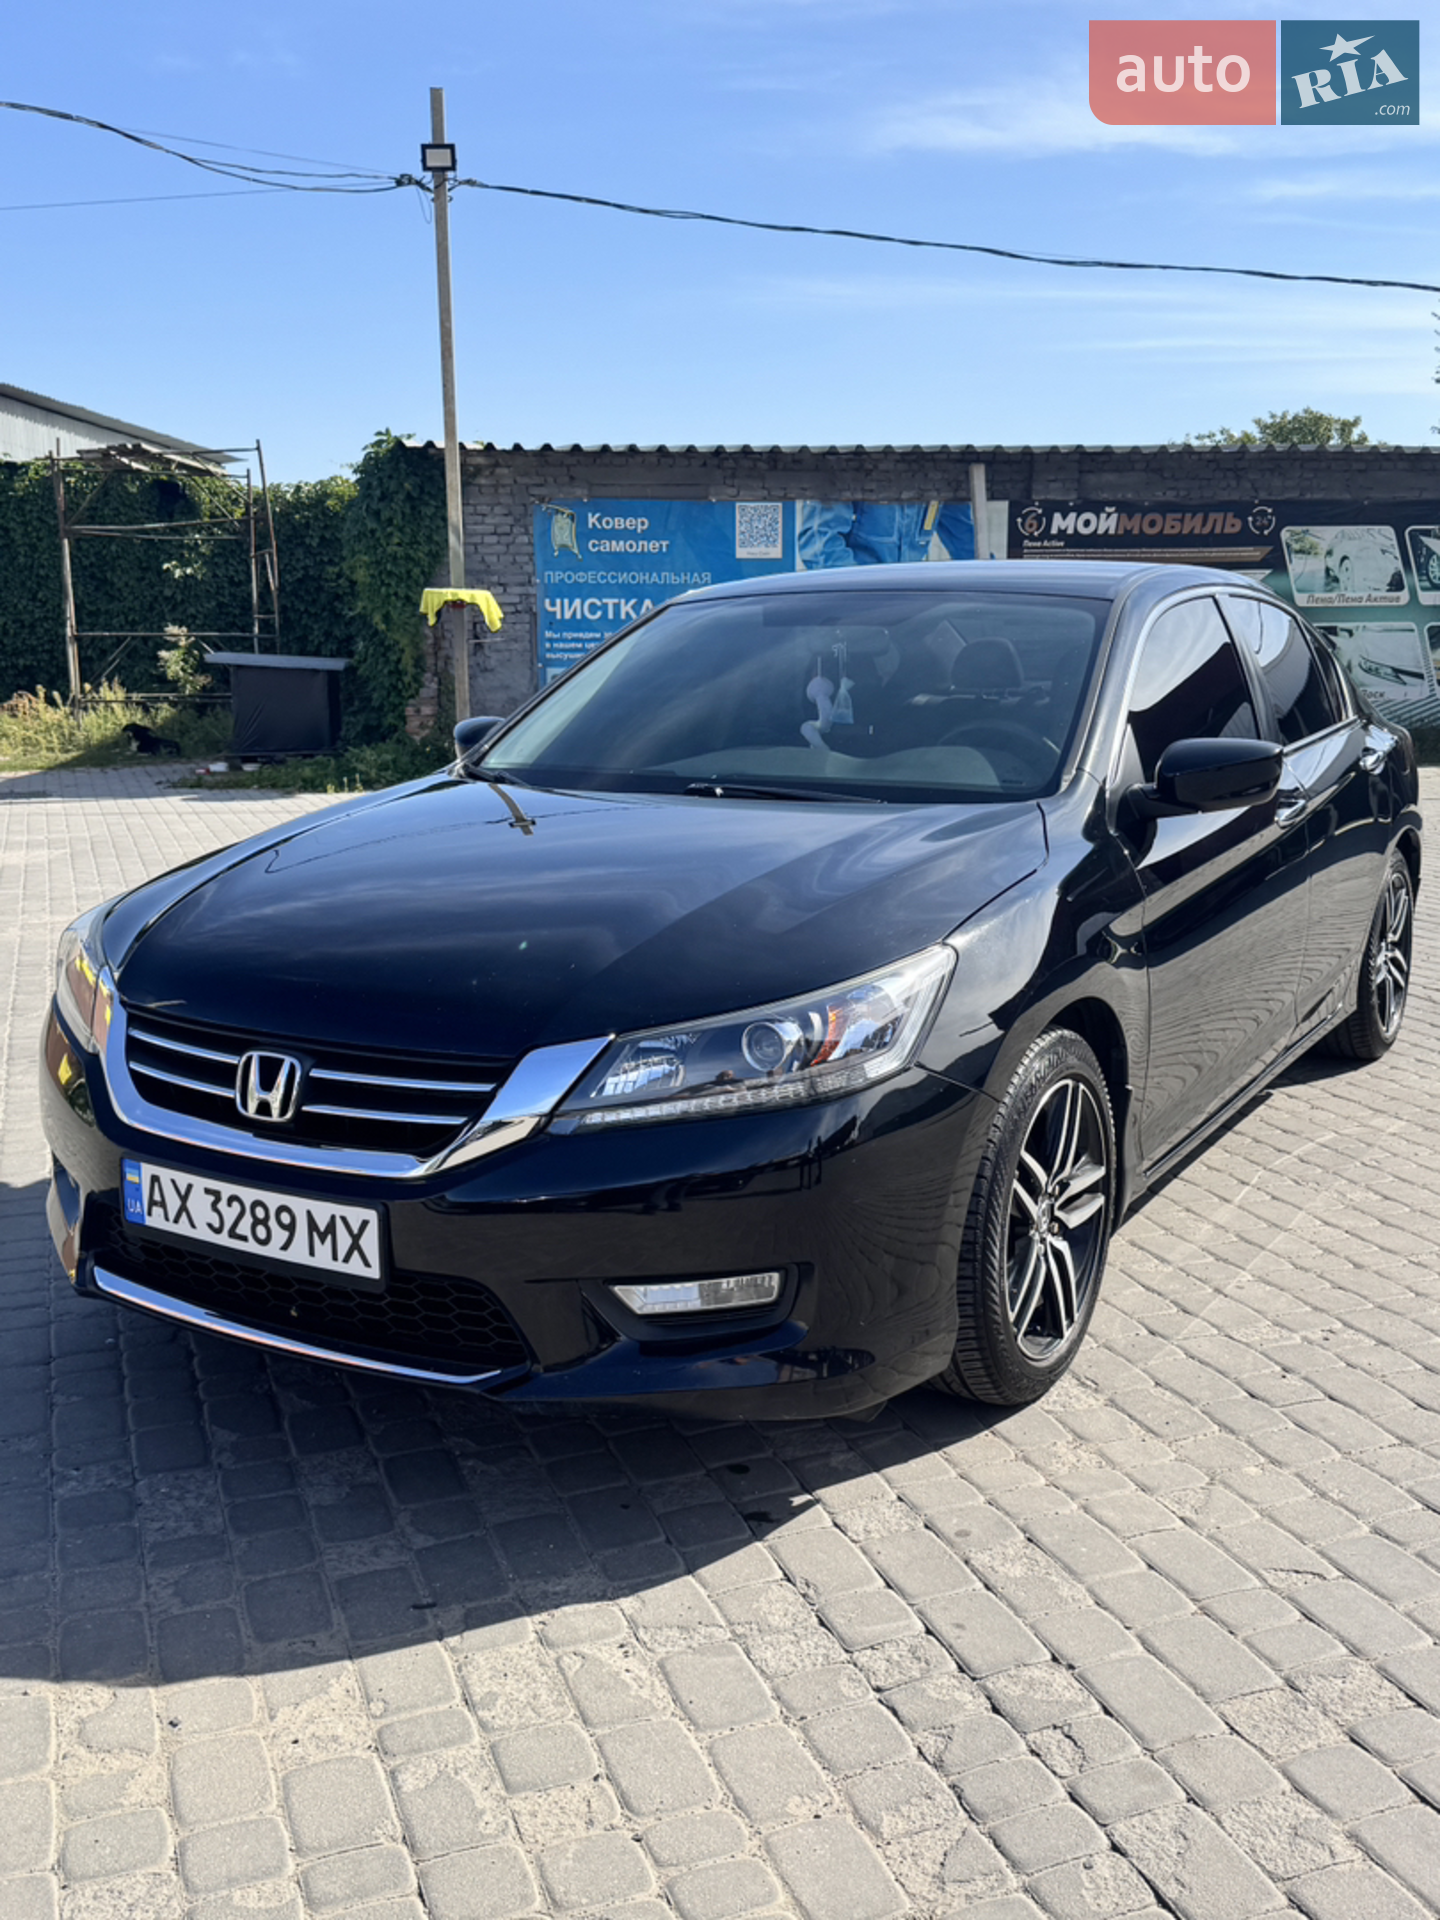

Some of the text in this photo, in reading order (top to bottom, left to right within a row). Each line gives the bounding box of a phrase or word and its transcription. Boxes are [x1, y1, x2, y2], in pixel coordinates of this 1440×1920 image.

[587, 512, 649, 534] Ковер
[587, 538, 670, 554] самолет
[543, 570, 712, 585] ПРОФЕССИОНАЛЬНАЯ
[544, 597, 655, 621] ЧИСТКА
[127, 1198, 143, 1214] UA
[146, 1174, 372, 1269] AX 3289 MX
